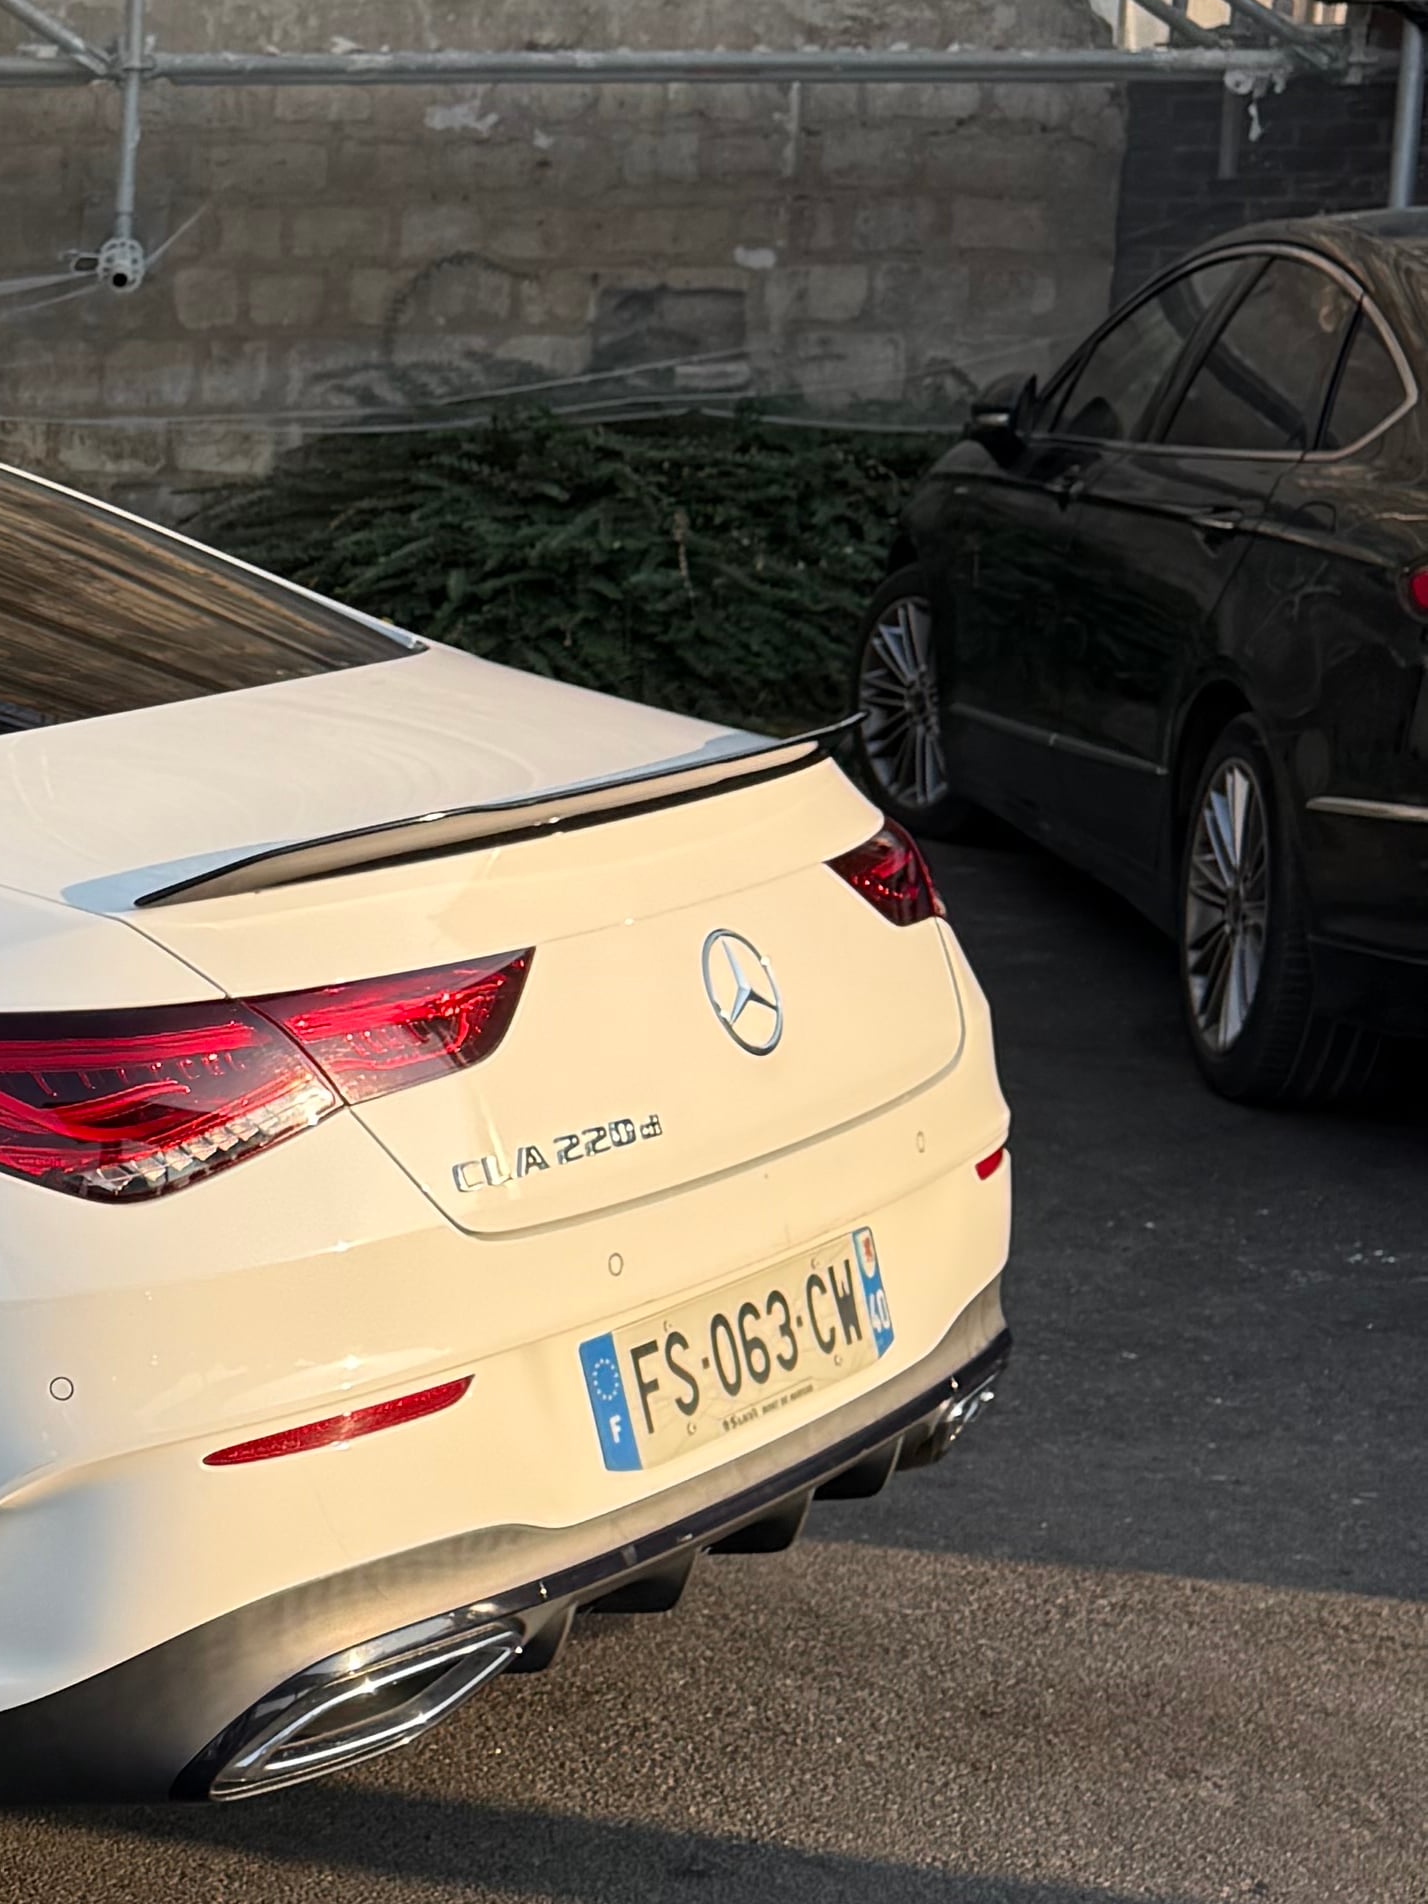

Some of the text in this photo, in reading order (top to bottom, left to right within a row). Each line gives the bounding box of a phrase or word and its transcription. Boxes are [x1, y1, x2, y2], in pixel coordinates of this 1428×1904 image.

[451, 1114, 663, 1193] CLA 220 d
[869, 1289, 892, 1334] 40
[630, 1259, 863, 1434] FS-063-CW
[608, 1414, 622, 1444] F
